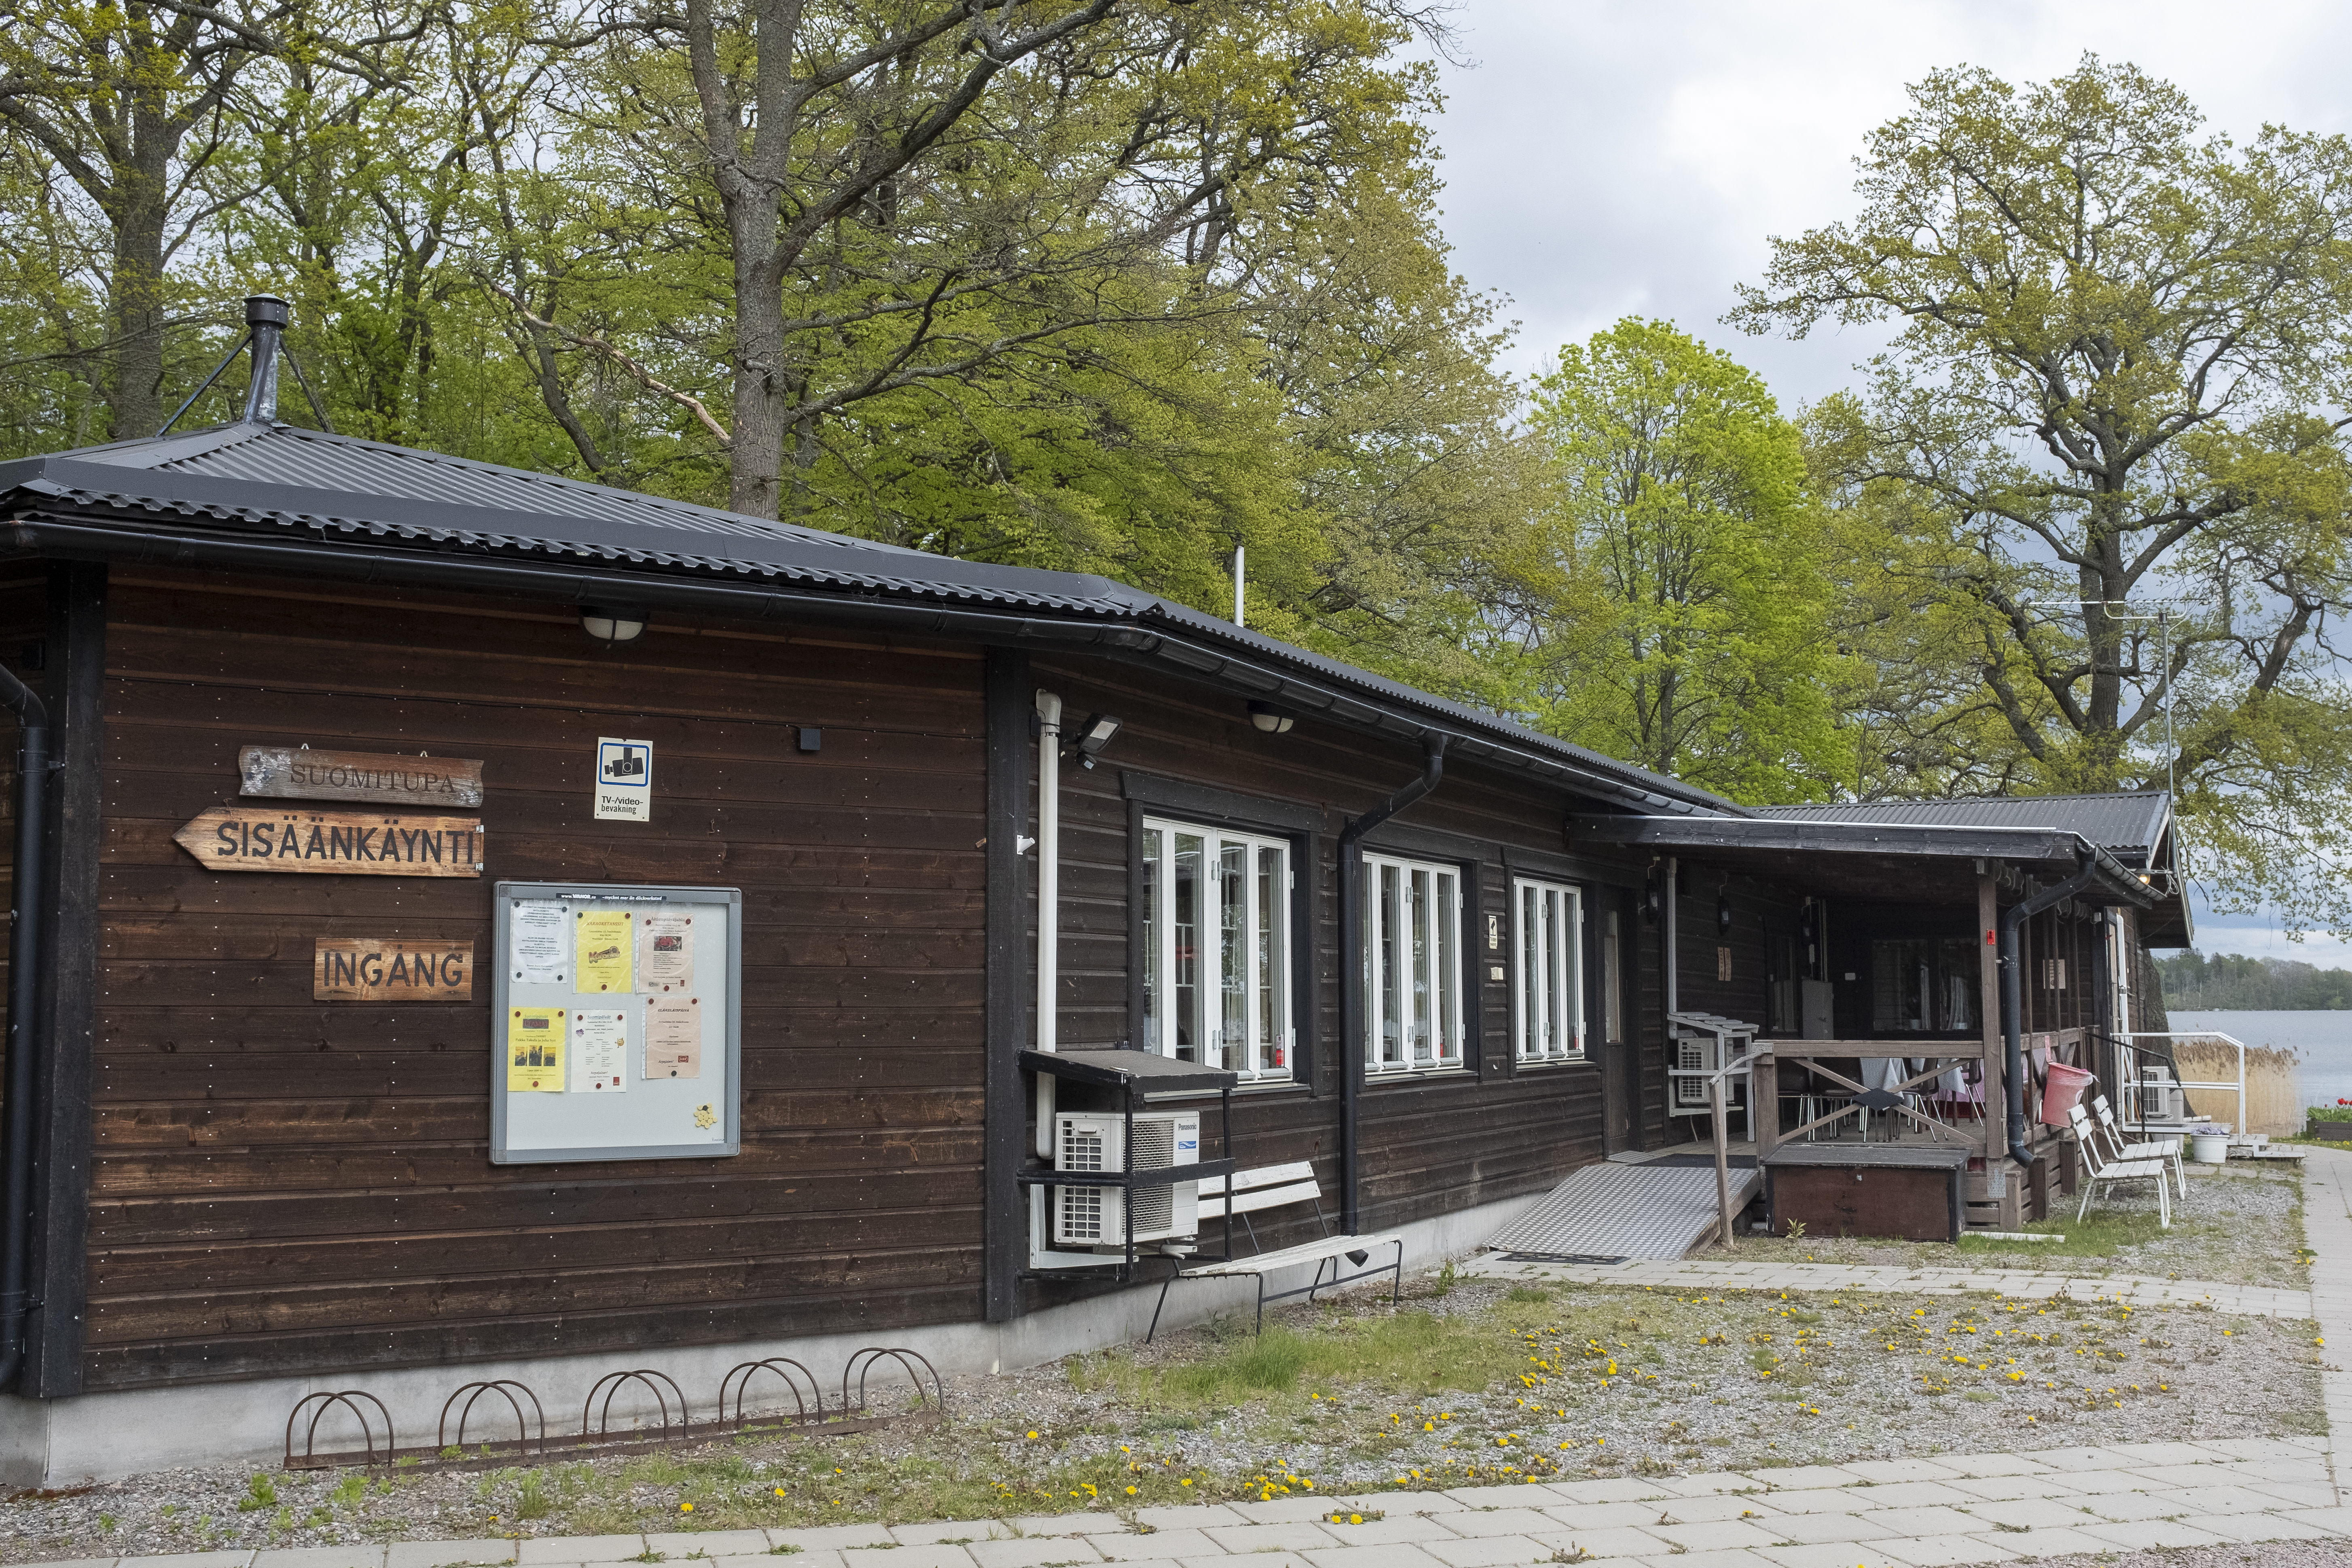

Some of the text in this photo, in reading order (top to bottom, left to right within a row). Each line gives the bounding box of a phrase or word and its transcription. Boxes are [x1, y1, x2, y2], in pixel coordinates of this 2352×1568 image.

[290, 764, 457, 794] SUOMITUPA
[601, 796, 643, 805] TV-/video-
[601, 804, 637, 815] bevakning
[217, 815, 474, 864] SISÄÄNKÄYNTI
[324, 944, 463, 987] INGÅNG
[1179, 1123, 1196, 1131] Panasonic
